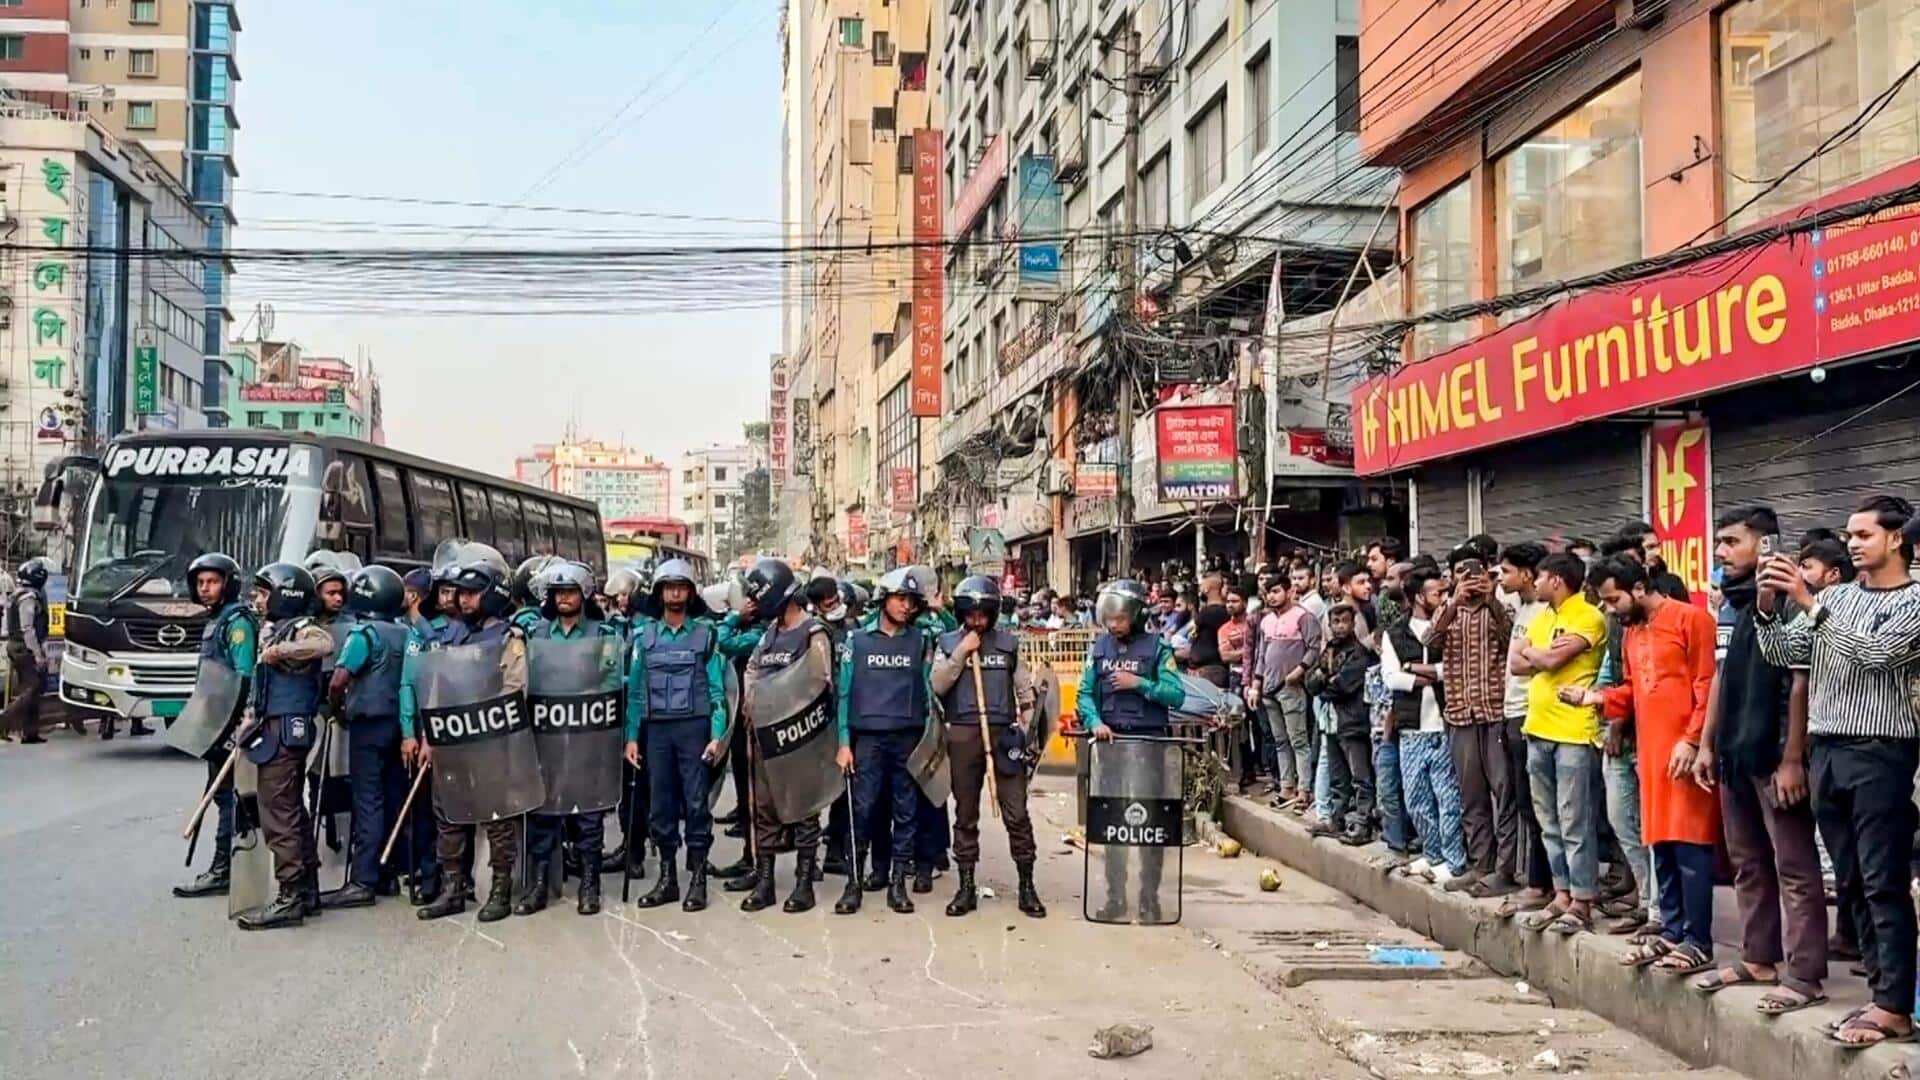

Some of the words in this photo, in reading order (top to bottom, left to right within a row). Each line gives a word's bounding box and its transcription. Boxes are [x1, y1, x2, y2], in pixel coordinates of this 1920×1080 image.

[1387, 357, 1502, 448] HIMEL
[1512, 273, 1788, 412] Furniture
[107, 446, 310, 477] PURBASHA
[1164, 484, 1231, 499] WALTON
[1662, 535, 1708, 593] IMEL
[867, 654, 911, 667] POLICE
[1101, 660, 1139, 671] POLICE
[429, 701, 521, 739] POLICE
[533, 699, 617, 727] POLICE
[775, 705, 826, 747] POLICE
[1106, 825, 1164, 843] POLICE
